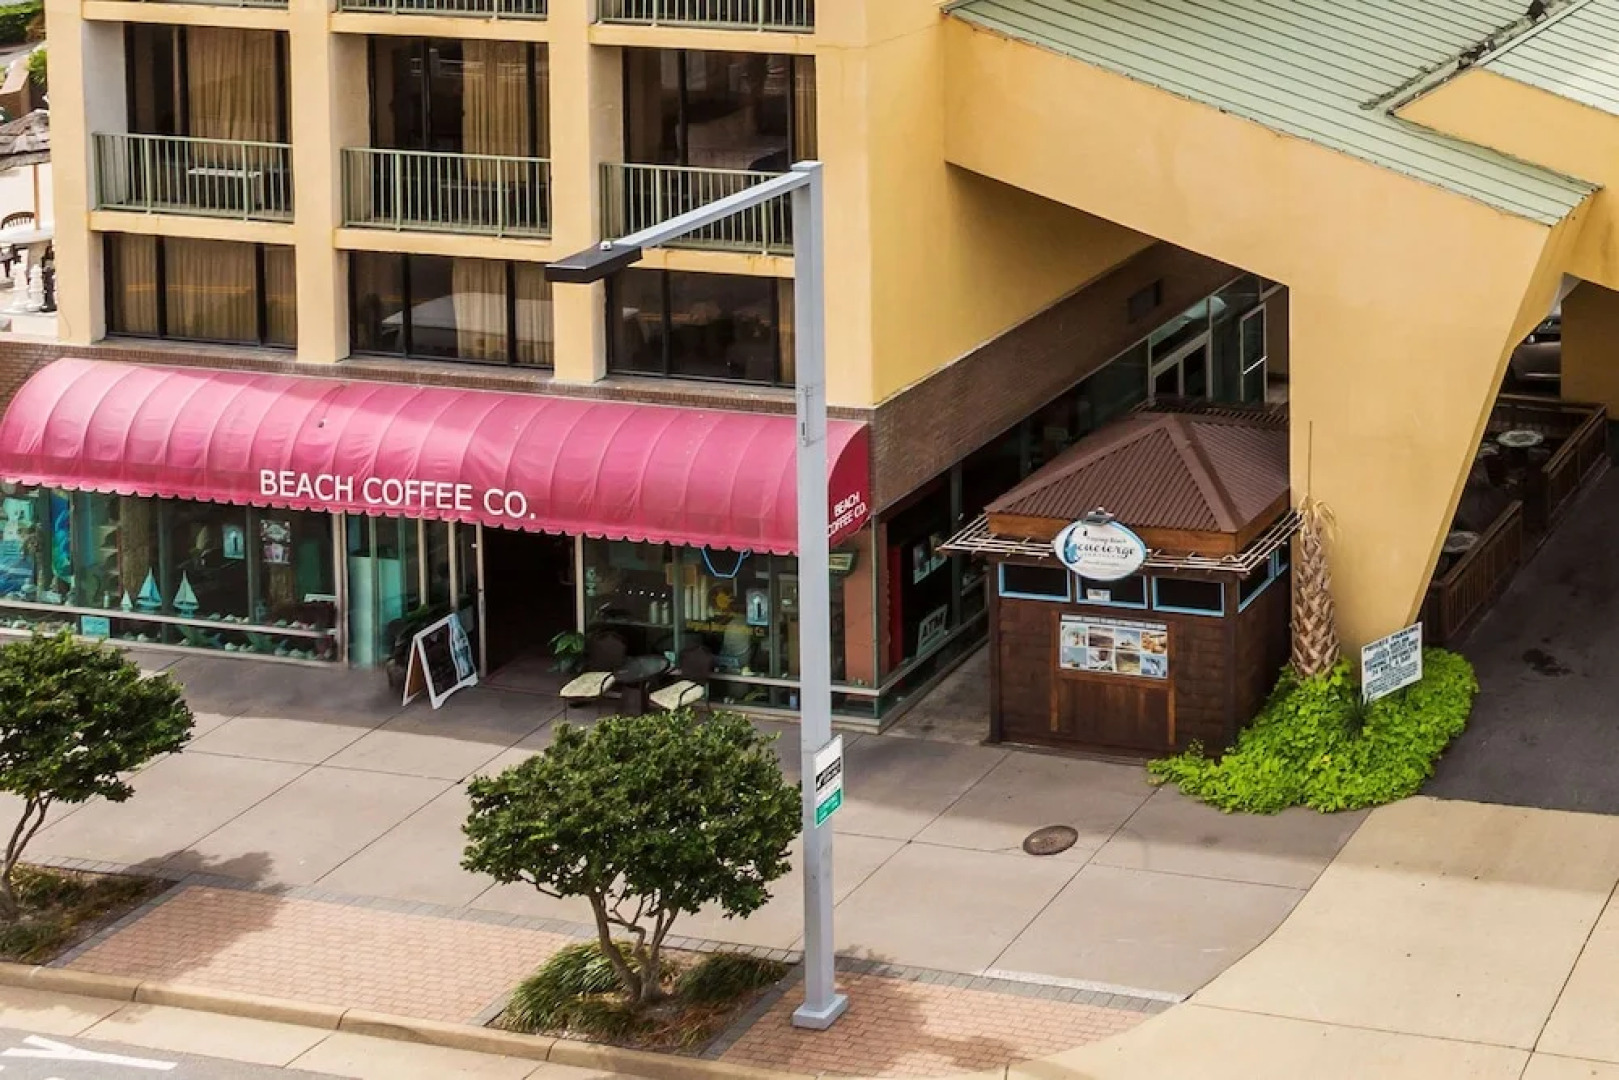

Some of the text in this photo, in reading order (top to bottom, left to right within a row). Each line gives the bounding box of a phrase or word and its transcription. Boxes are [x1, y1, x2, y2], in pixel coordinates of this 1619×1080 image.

[260, 469, 536, 519] BEACH COFFEE CO.
[833, 491, 861, 518] BEACH
[922, 611, 944, 639] ATM
